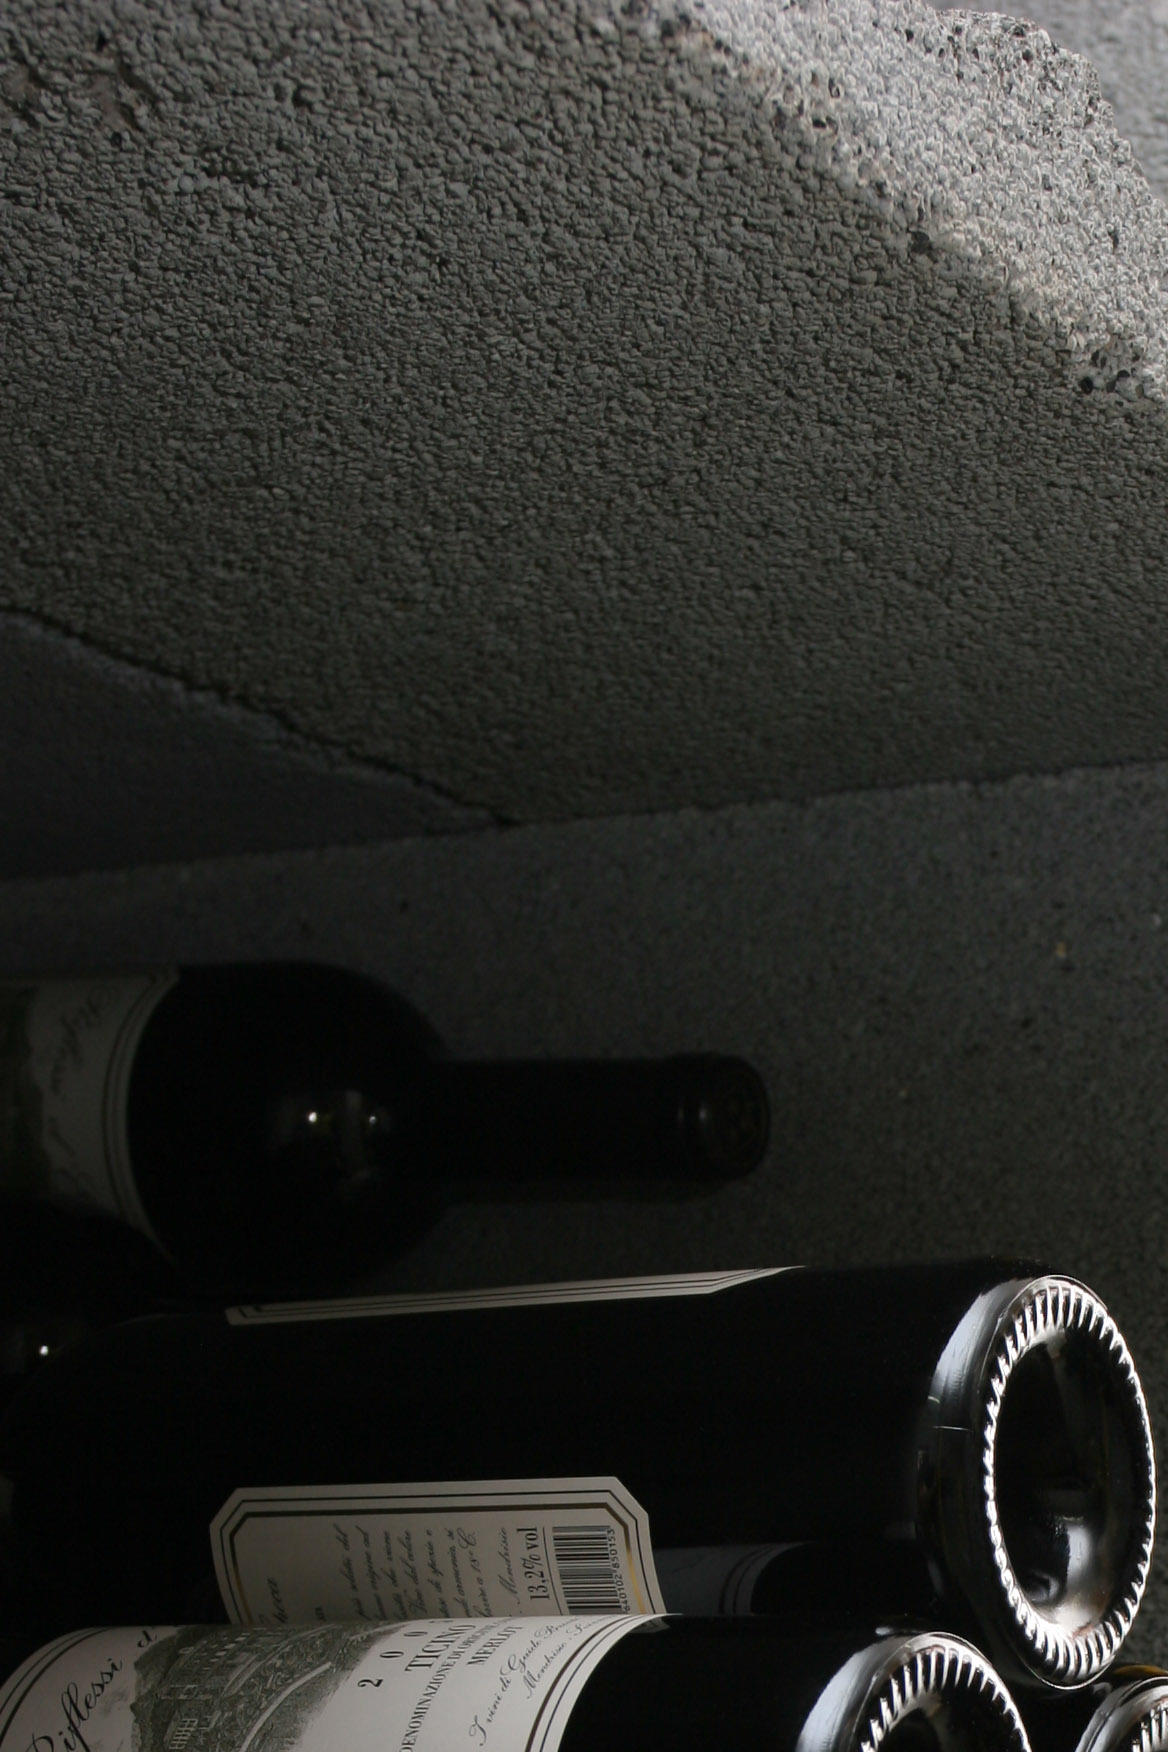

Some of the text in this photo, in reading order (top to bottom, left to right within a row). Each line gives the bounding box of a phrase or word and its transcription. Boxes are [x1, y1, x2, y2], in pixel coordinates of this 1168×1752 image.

[516, 1526, 550, 1600] 13,2% vol
[404, 1624, 476, 1672] TICINO
[466, 1626, 523, 1668] MERLOT
